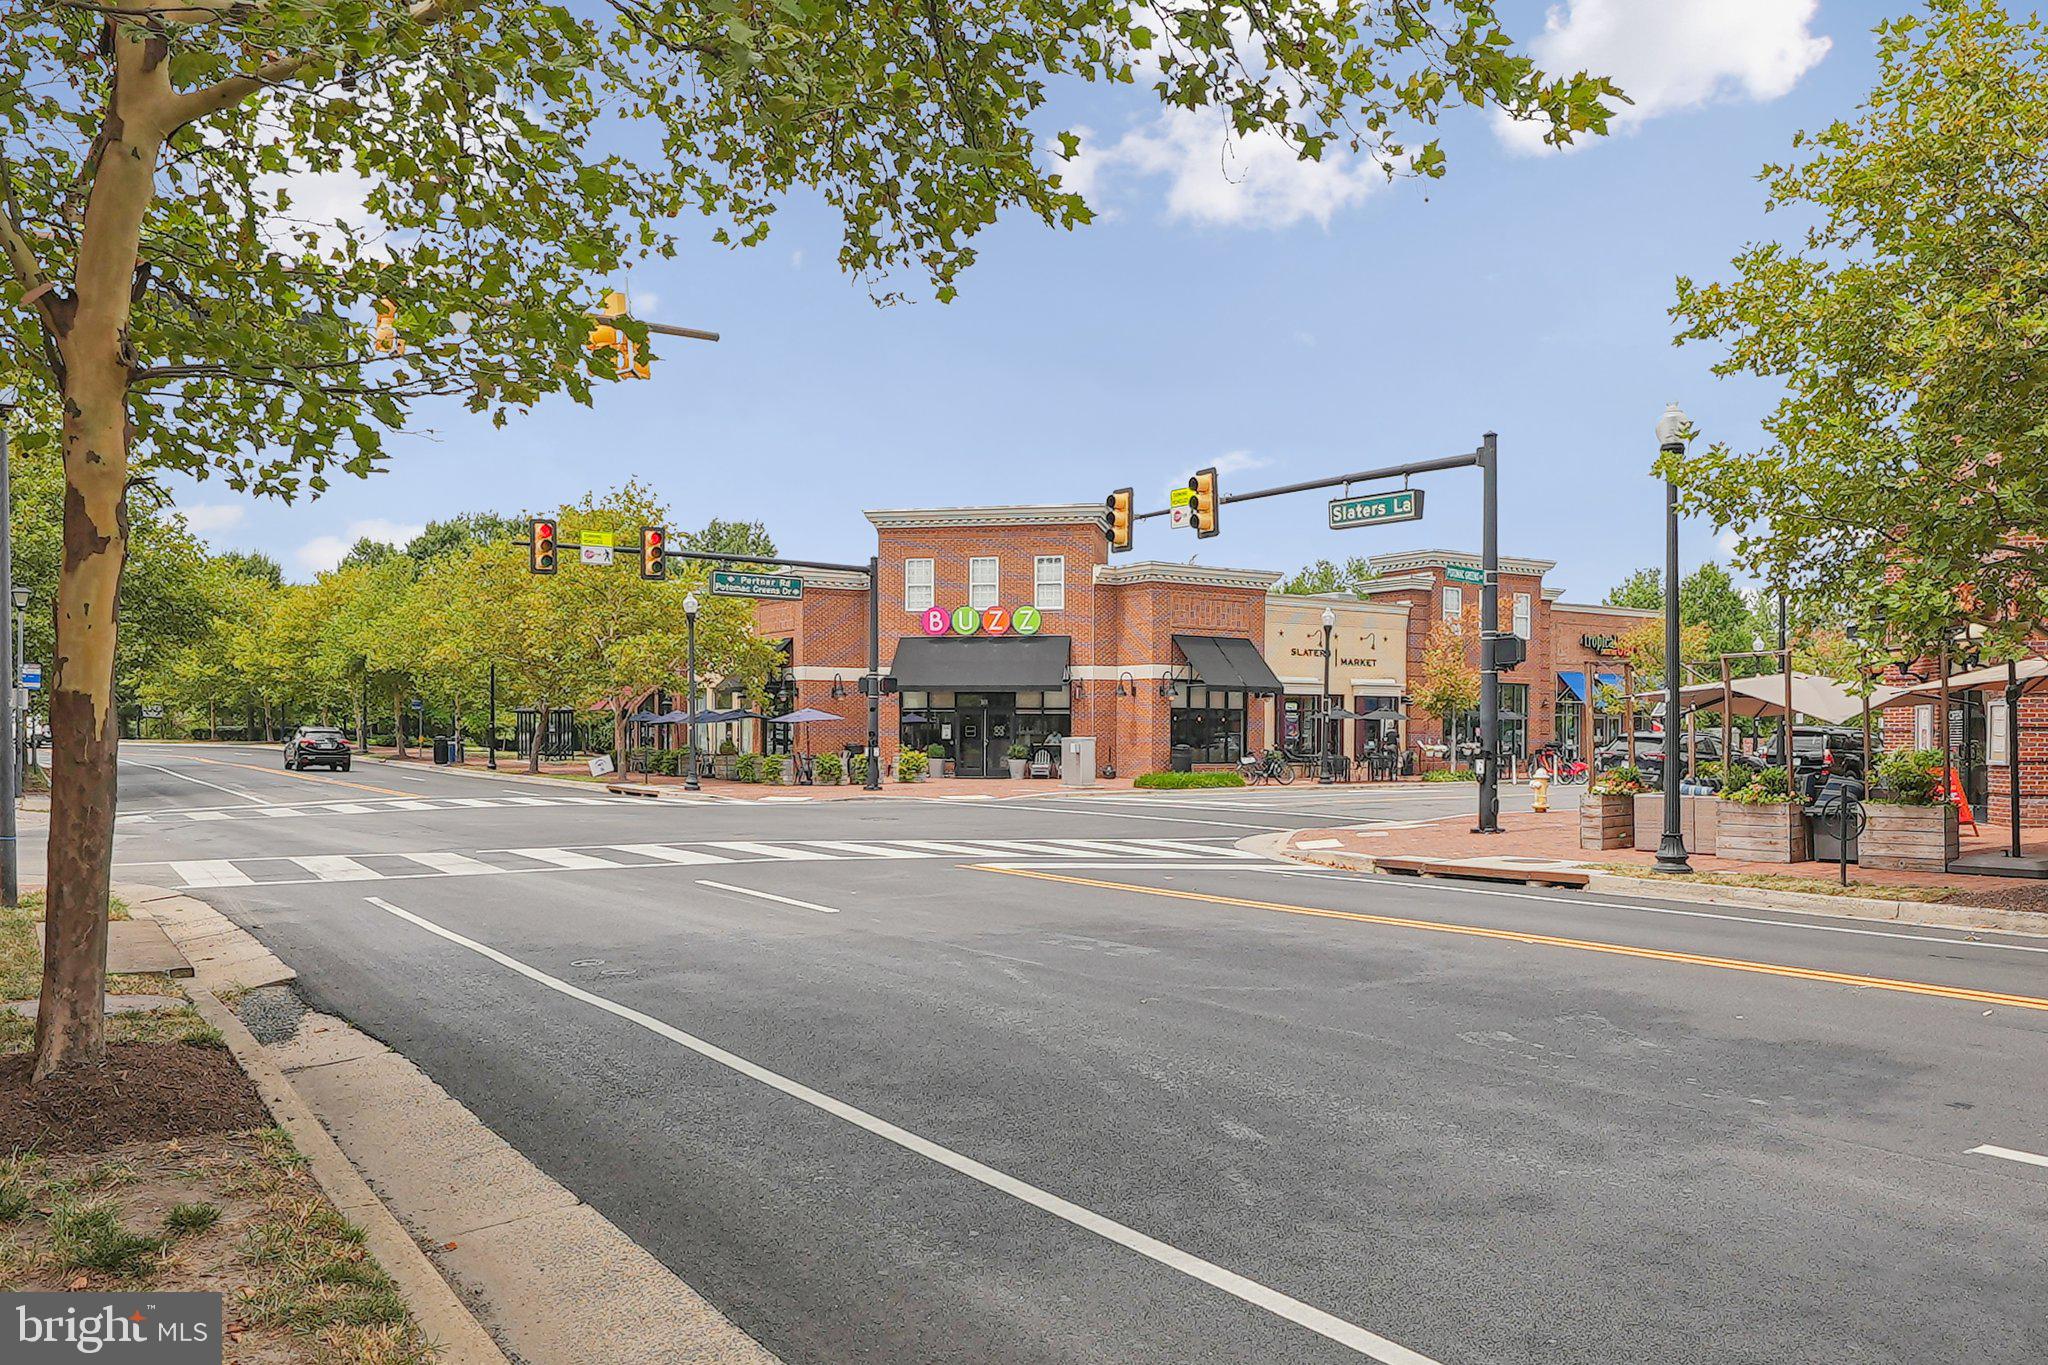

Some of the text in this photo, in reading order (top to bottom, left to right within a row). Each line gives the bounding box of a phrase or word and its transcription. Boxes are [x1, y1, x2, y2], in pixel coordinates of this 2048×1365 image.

[1333, 499, 1412, 521] Slaters La
[715, 582, 751, 593] Potomac
[752, 586, 780, 595] Greens
[780, 579, 791, 588] Rd
[929, 610, 1034, 631] BUZZ
[1340, 658, 1377, 667] MARKET
